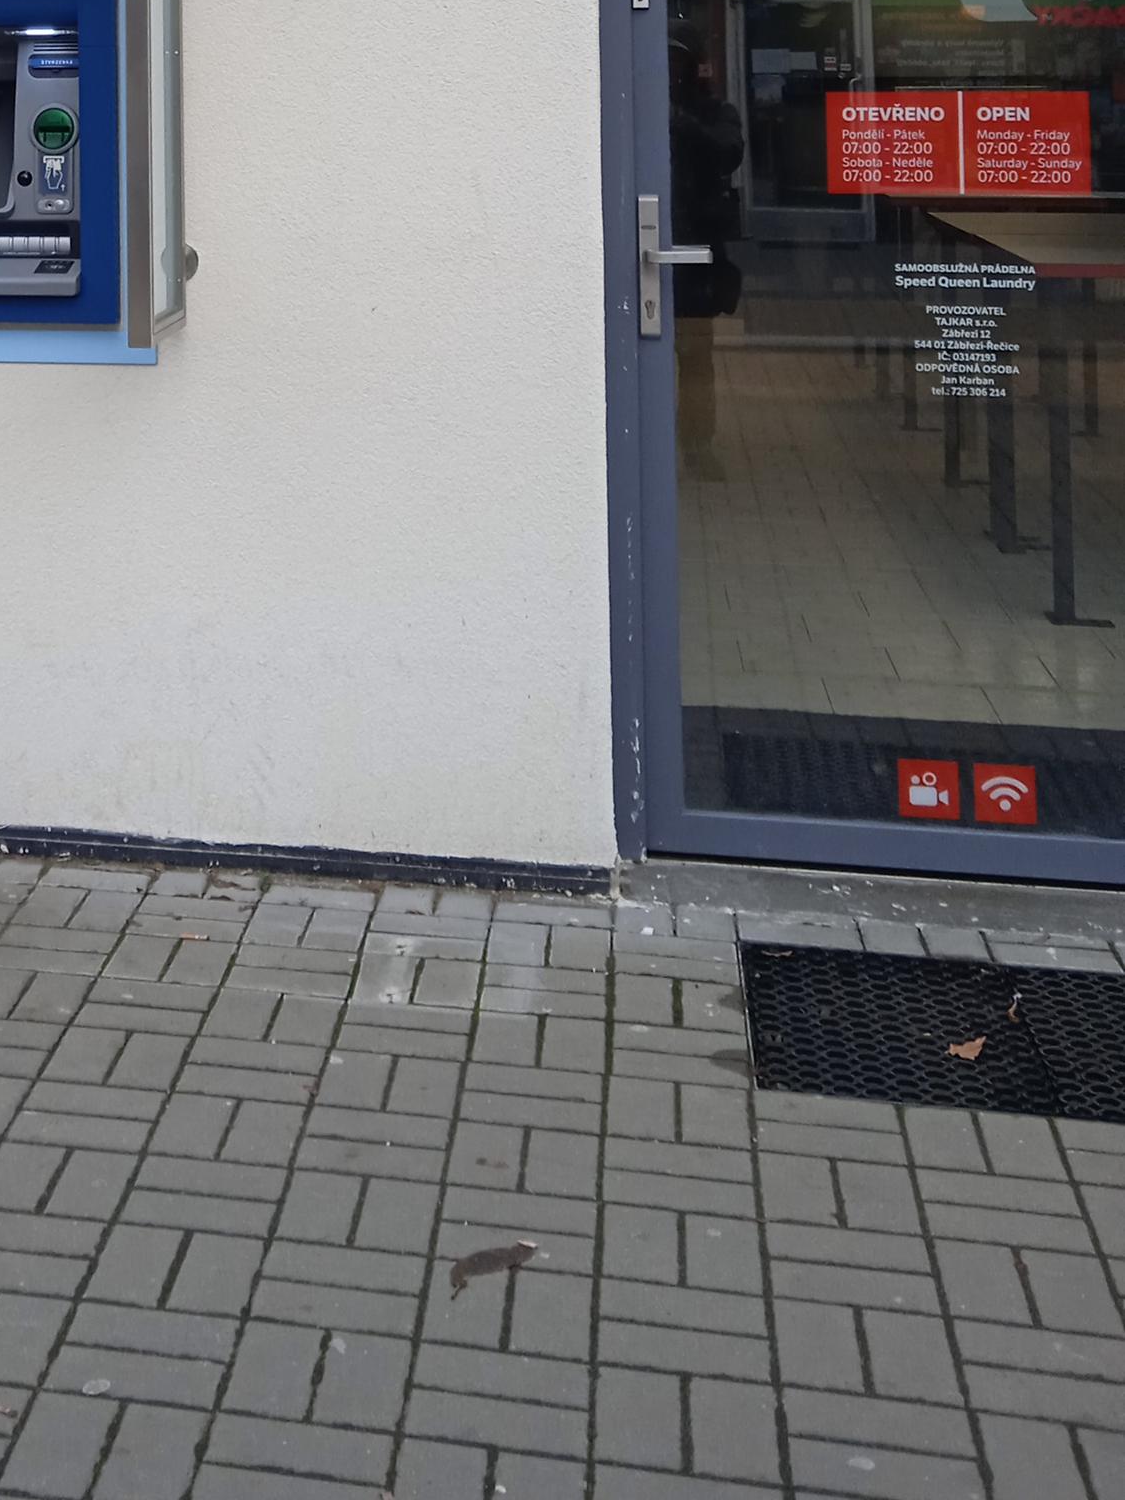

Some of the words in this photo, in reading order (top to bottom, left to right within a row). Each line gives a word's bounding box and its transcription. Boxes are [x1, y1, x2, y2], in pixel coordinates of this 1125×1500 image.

[842, 103, 945, 121] OTEVŘENO
[976, 106, 1030, 121] OPEN
[842, 129, 884, 139] Pondělí
[894, 129, 925, 140] Pátek
[977, 129, 1024, 141] Monday
[1034, 129, 1070, 141] Friday
[842, 141, 881, 154] 07:00
[893, 141, 932, 154] 22:00
[977, 141, 1017, 155] 07:00
[1030, 141, 1070, 155] 22:00
[842, 156, 883, 168] Sobota
[892, 157, 933, 168] Neděle
[977, 157, 1028, 170] Saturday
[1037, 158, 1082, 171] Sunday
[842, 169, 881, 182] 07:00
[893, 169, 933, 182] 22:00
[977, 170, 1018, 183] 07:00
[1030, 170, 1071, 183] 22:00
[894, 263, 979, 273] SAMOOBSLUŽNÁ
[980, 264, 1035, 274] PRÁDELNA
[895, 276, 936, 288] Speed
[938, 276, 980, 288] Queen
[982, 277, 1035, 291] Laundry
[925, 305, 1007, 316] PROVOZOVATEL
[935, 317, 973, 327] TAJKAR
[980, 330, 991, 339] 12
[914, 340, 932, 349] 544
[934, 341, 946, 349] 01
[915, 363, 980, 373] ODPOVĚDNÁ
[982, 365, 1020, 374] OSOBA
[940, 375, 958, 385] Jan
[959, 376, 995, 385] Karban
[951, 388, 968, 396] 725
[970, 388, 987, 396] 306
[989, 388, 1006, 397] 214
